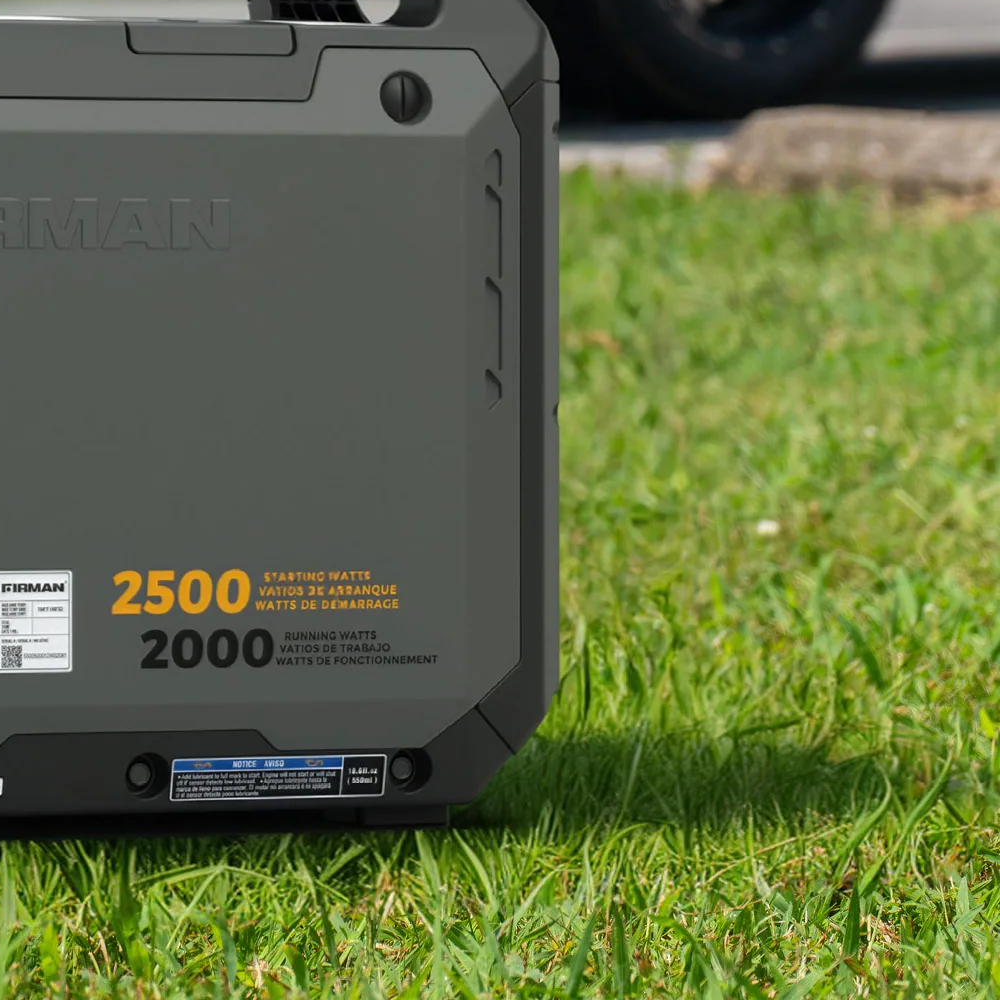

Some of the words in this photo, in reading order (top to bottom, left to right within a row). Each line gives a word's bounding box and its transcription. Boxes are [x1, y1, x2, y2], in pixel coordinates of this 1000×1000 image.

[263, 571, 325, 583] STARTING
[328, 570, 371, 581] WATTS
[1, 583, 65, 593] FIRMAN
[111, 568, 251, 615] 2500
[259, 585, 304, 597] VATIOS
[307, 585, 325, 596] DE
[328, 584, 397, 596] ARRANQUE
[255, 599, 297, 611] WATTS
[301, 599, 317, 610] DE
[284, 631, 337, 642] RUNNING
[339, 630, 377, 641] WATTS
[140, 628, 274, 669] 2000
[279, 644, 319, 654] VATIOS
[323, 644, 337, 653] DE
[341, 642, 391, 653] TRABAJO
[275, 656, 314, 667] WATTS
[316, 656, 332, 666] DE
[334, 655, 438, 665] FONCTIONNEMENT
[232, 760, 257, 768] NOTICE
[263, 759, 284, 768] AVISO
